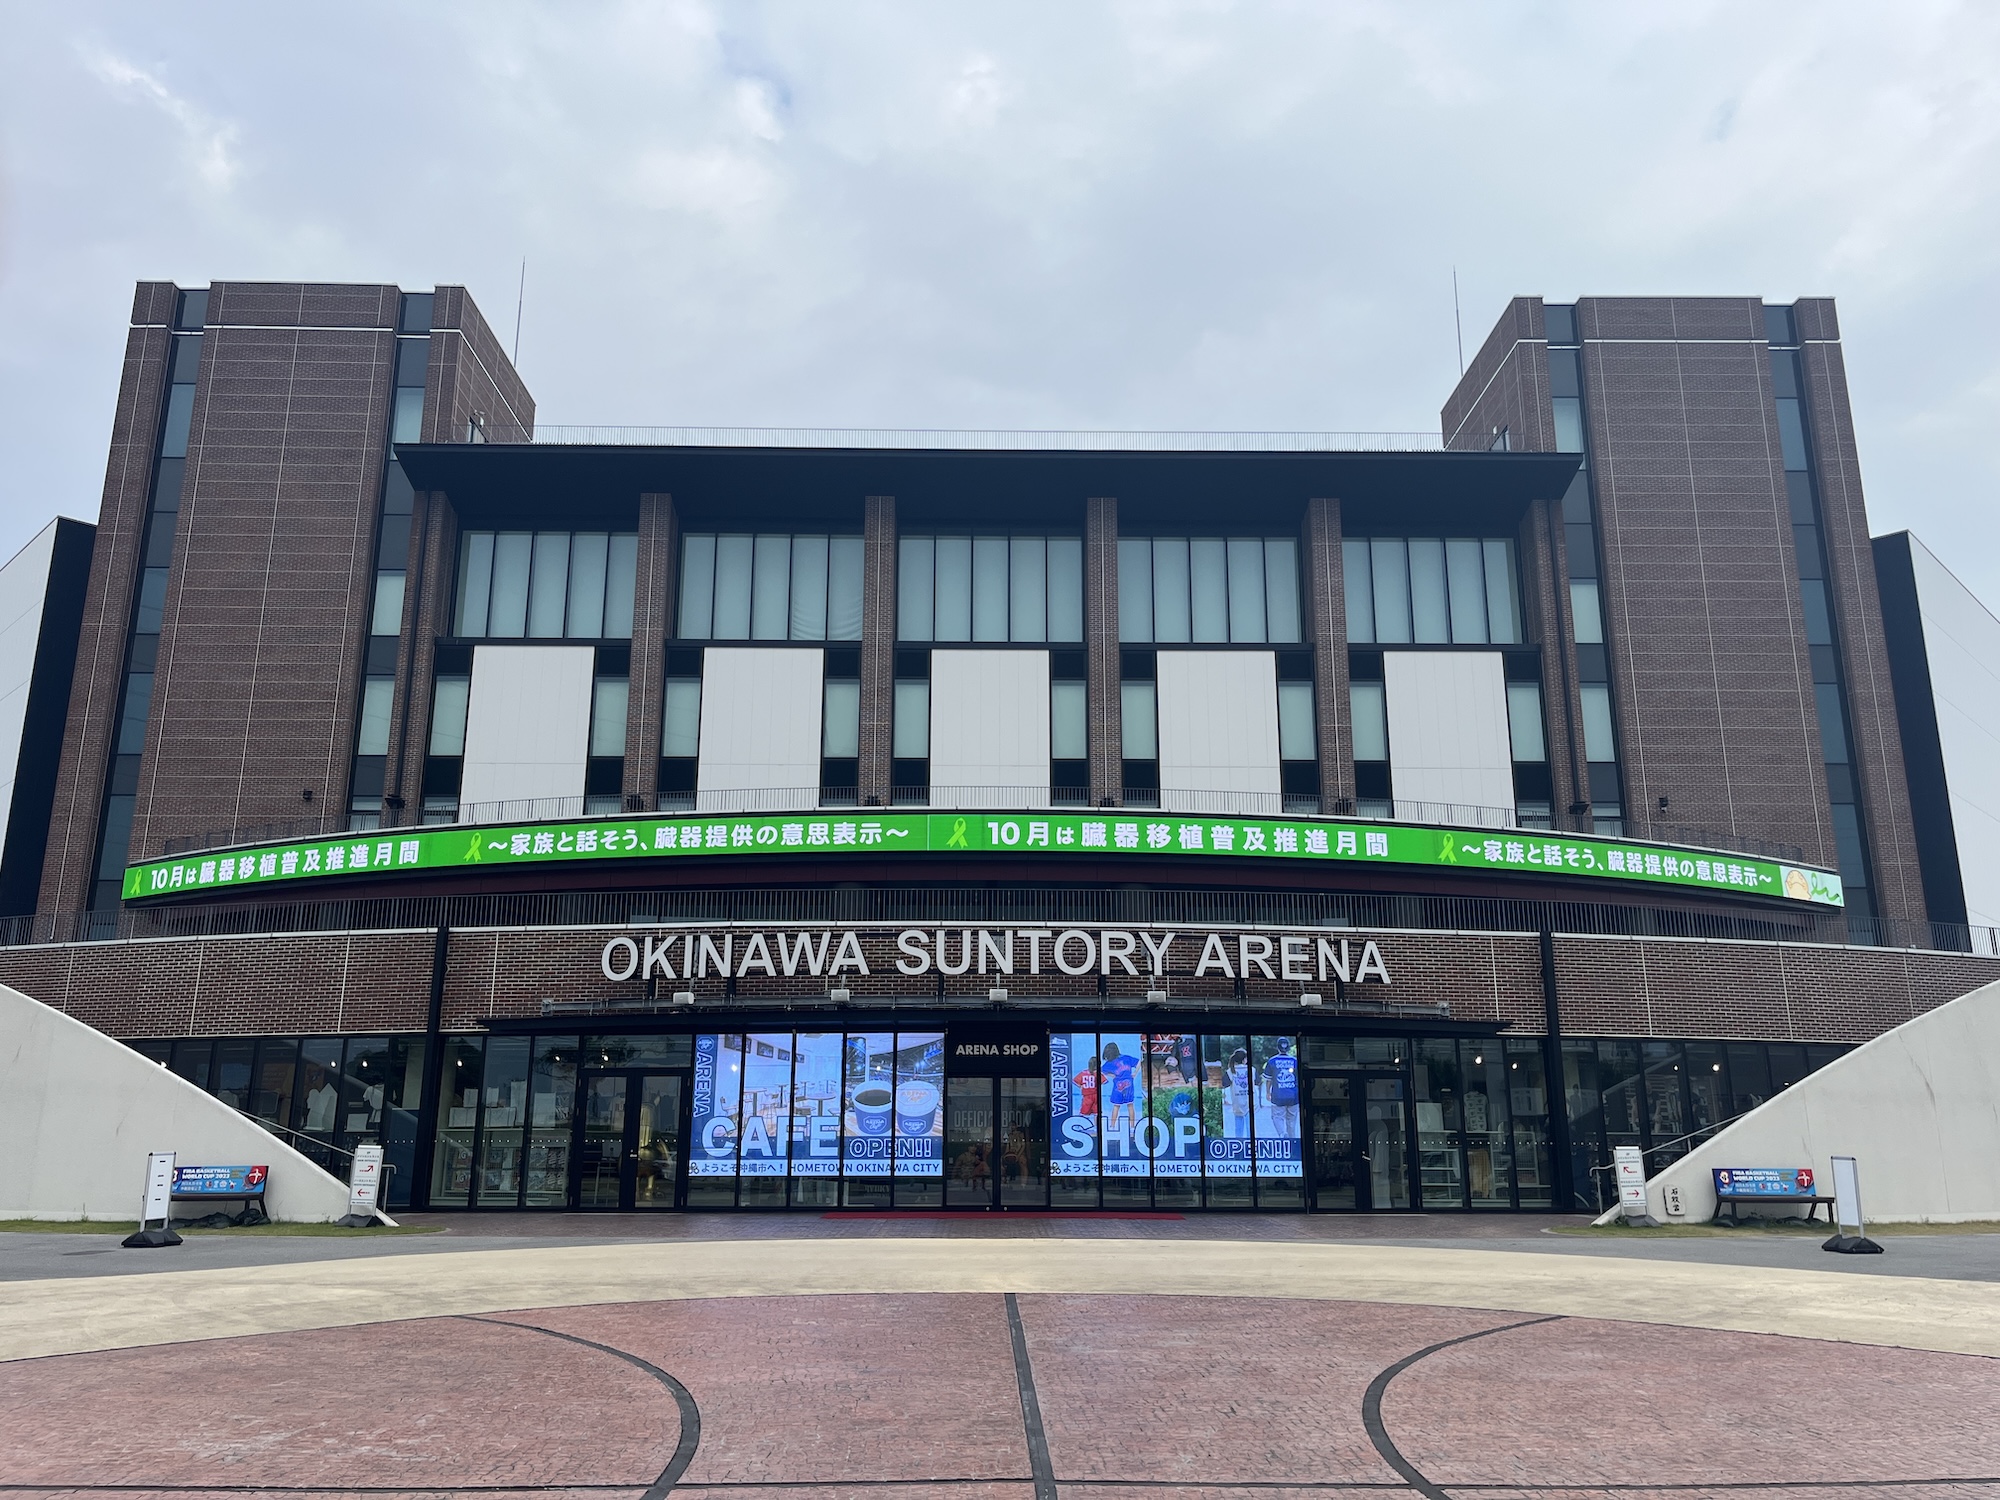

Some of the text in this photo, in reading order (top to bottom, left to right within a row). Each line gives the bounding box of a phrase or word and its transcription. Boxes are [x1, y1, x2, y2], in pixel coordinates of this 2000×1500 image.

[988, 821, 1389, 857] 10月は臓器移植普及推進月間
[151, 840, 420, 890] 10月は臓器移植普及推進月間
[601, 929, 1392, 984] OKINAWA SUNTORY ARENA
[956, 1044, 1039, 1056] ARENA SHOP
[693, 1052, 713, 1118] ARENA
[1051, 1051, 1069, 1118] ARENA
[1082, 1076, 1095, 1089] 58
[702, 1116, 932, 1158] CAFE OPEN!!
[1061, 1116, 1291, 1159] SHOP OPEN!!
[912, 1163, 940, 1172] CITY
[1273, 1164, 1300, 1174] CITY
